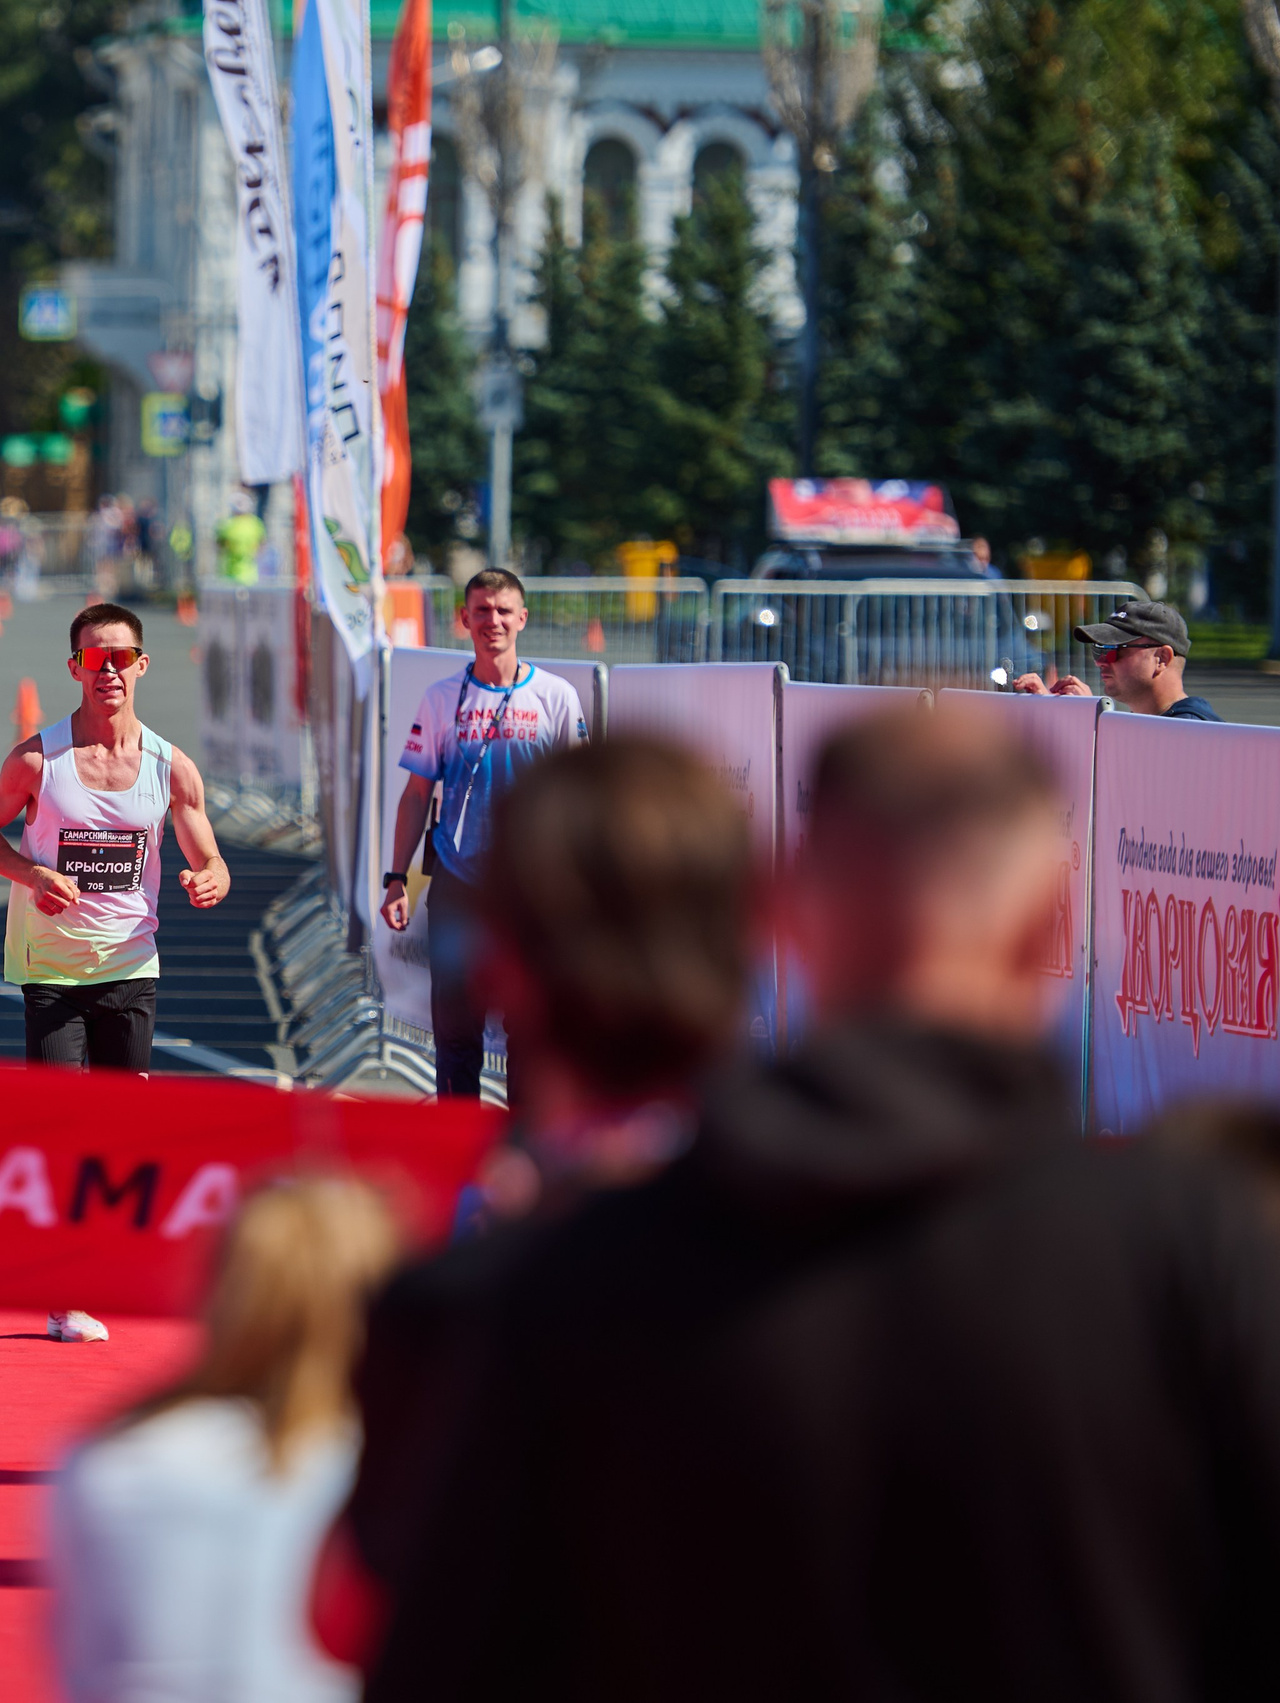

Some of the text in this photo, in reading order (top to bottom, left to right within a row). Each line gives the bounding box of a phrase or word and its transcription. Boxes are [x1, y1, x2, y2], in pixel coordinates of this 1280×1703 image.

[459, 707, 538, 723] САМАСКИЙ
[63, 831, 108, 840] САМАРСКИЙ
[65, 861, 132, 873] КРЫСЛОВ
[1118, 826, 1278, 894] Природная вода для вашего здоровья!
[87, 882, 104, 890] 705
[1115, 887, 1279, 1060] ДВОРЦОВАЯ
